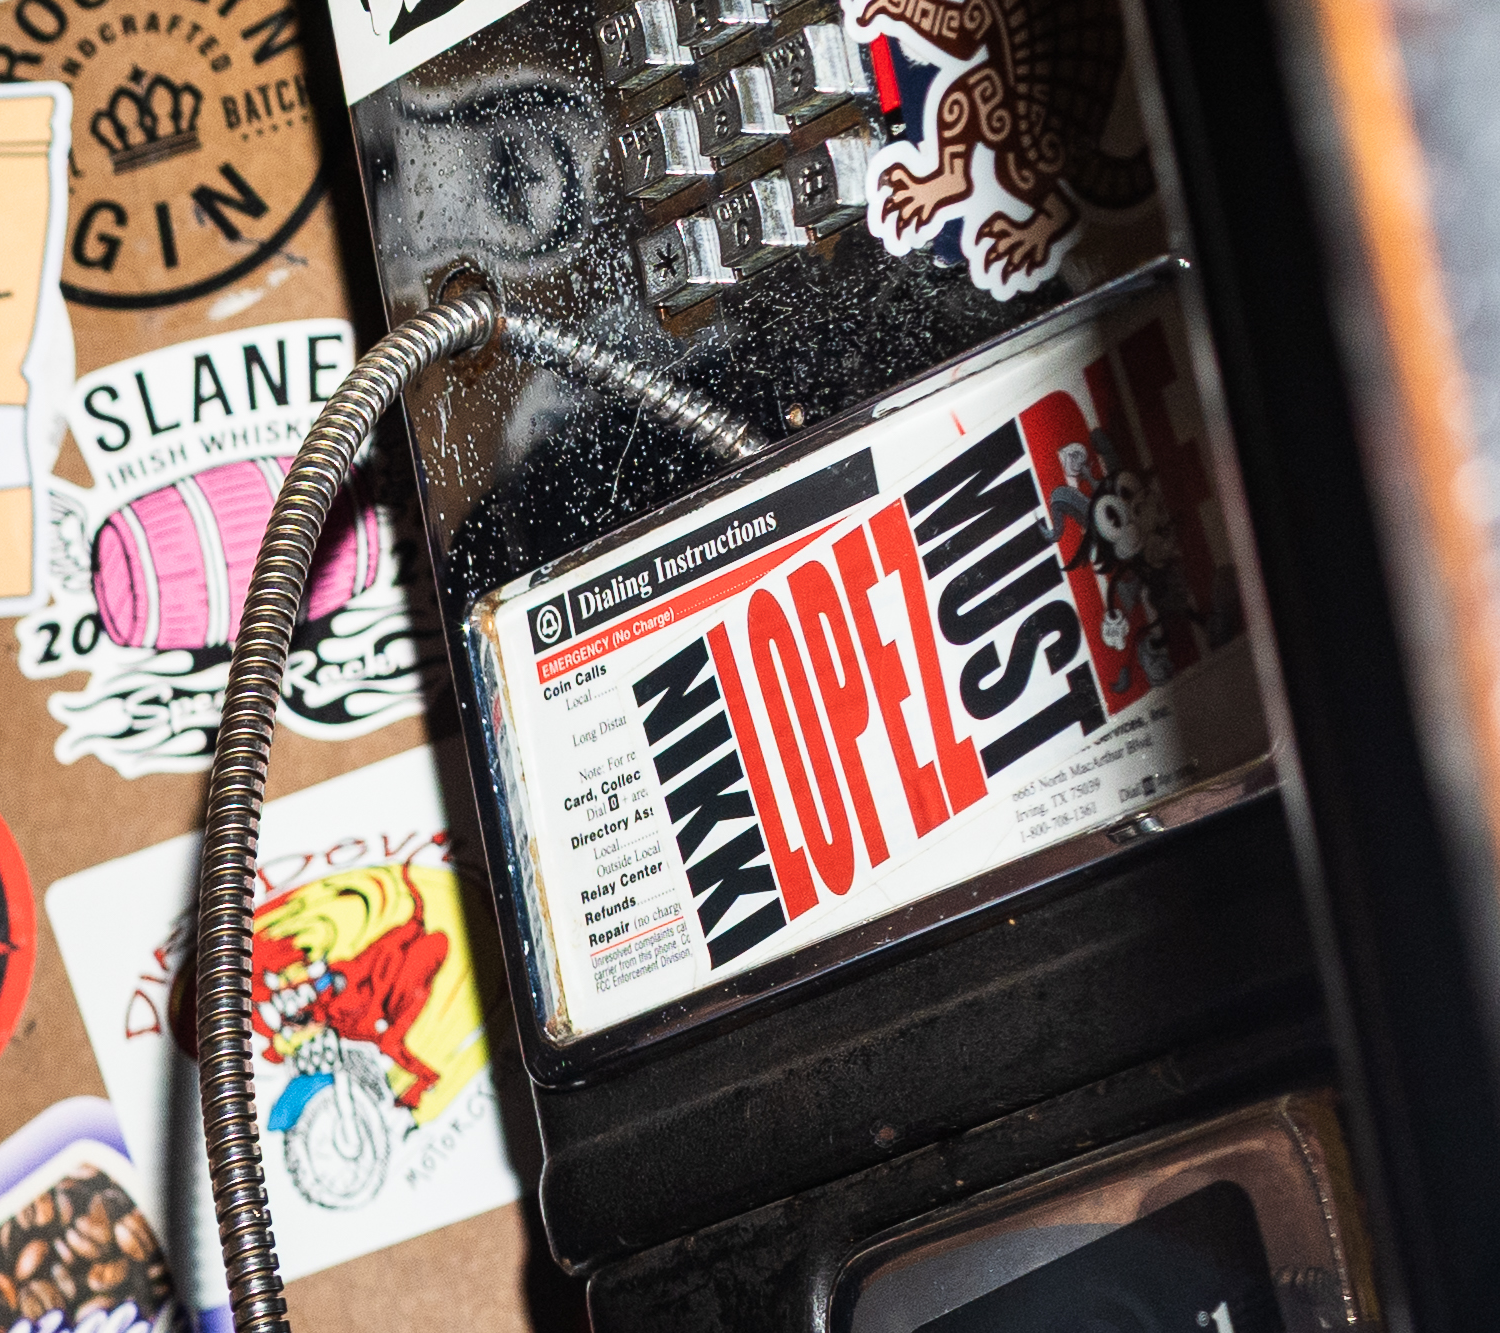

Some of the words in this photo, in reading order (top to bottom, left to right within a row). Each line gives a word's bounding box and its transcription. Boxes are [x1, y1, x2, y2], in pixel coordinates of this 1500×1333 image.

[614, 39, 634, 69] 4
[713, 110, 729, 138] 8
[638, 150, 654, 180] 7
[71, 161, 269, 272] GIN
[82, 331, 345, 456] SLANE
[105, 441, 186, 492] IRISH
[578, 566, 652, 622] Dialing
[652, 505, 778, 583] Instructions
[904, 416, 1107, 781] MUST
[540, 638, 610, 679] EMERGENCY
[612, 629, 631, 648] (No
[633, 606, 676, 637] Charge)
[543, 681, 572, 701] Coin
[575, 663, 607, 687] Calls
[566, 690, 592, 712] Local
[707, 497, 989, 923] LOPEZ
[572, 727, 597, 748] Long
[579, 763, 606, 784] Note:
[607, 756, 624, 771] For
[1039, 770, 1068, 789] North
[1069, 748, 1125, 776] MacArthur
[564, 788, 598, 811] Card,
[601, 769, 641, 796] Collec
[631, 636, 788, 972] NIKKI
[1051, 794, 1068, 808] TX
[586, 800, 607, 822] Dial
[570, 817, 629, 850] Directory
[593, 840, 620, 861] Local
[596, 856, 632, 878] Outside
[635, 840, 661, 863] Local
[581, 880, 616, 905] Relay
[620, 861, 663, 888] Center
[585, 896, 636, 927] Refunds
[588, 921, 630, 948] Repair
[634, 913, 651, 931] (no
[591, 942, 633, 970] Unresolved
[634, 928, 675, 952] complaints
[593, 964, 617, 982] carrier
[619, 956, 638, 974] from
[639, 949, 653, 963] this
[595, 979, 611, 994] FCC
[612, 961, 659, 988] Enforcement
